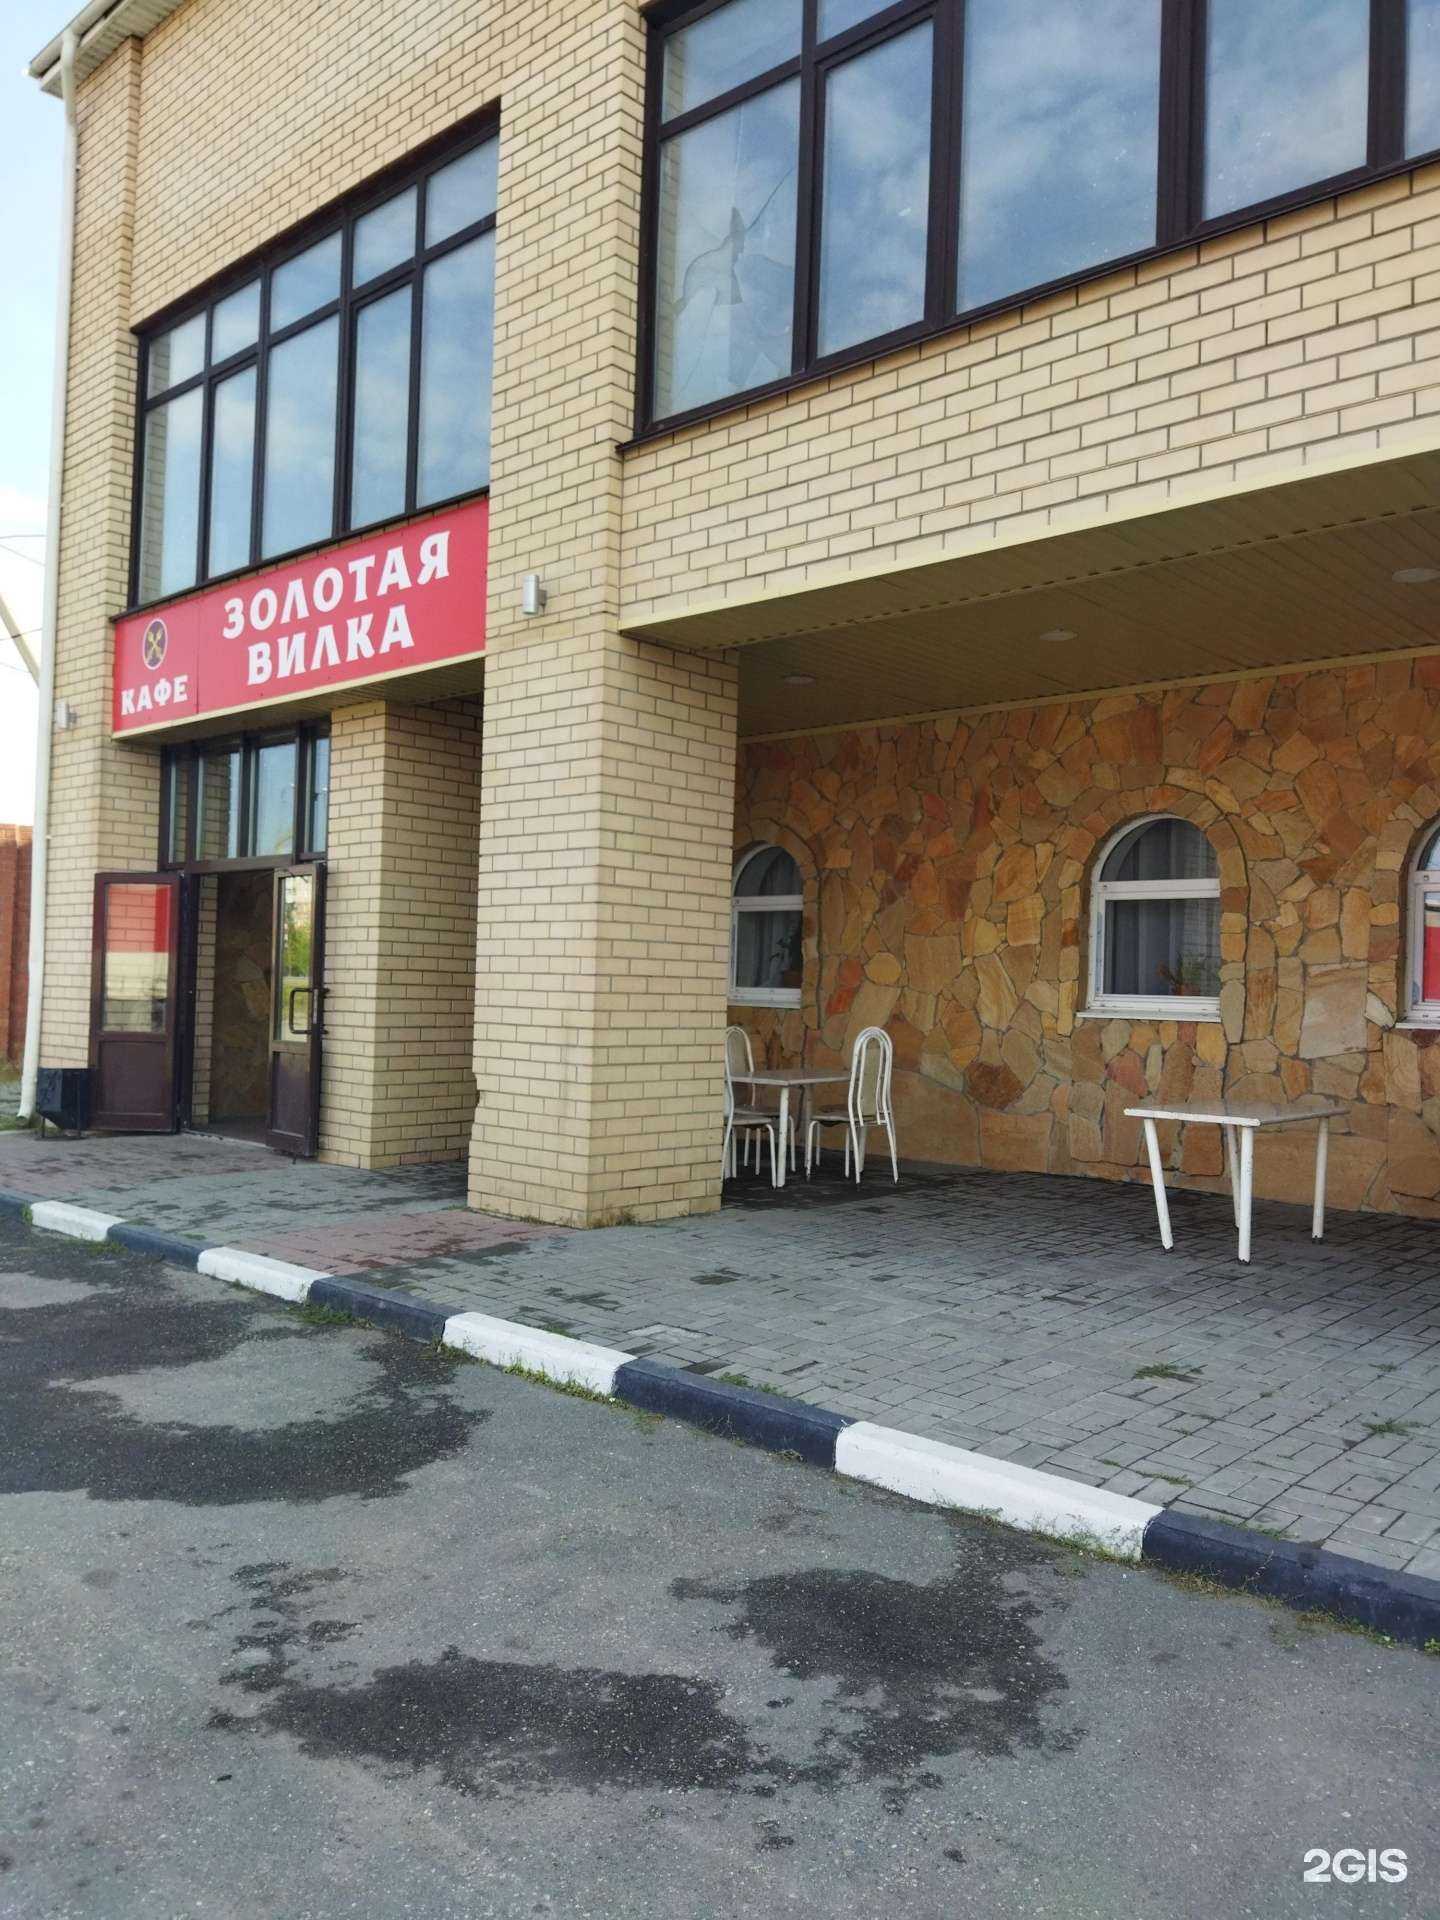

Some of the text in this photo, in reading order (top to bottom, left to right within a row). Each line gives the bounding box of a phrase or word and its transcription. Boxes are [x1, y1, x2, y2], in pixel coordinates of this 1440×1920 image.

[223, 531, 450, 639] ЗОЛОТАЯ
[247, 604, 415, 686] ВИЛКА
[120, 674, 188, 716] КАФЕ
